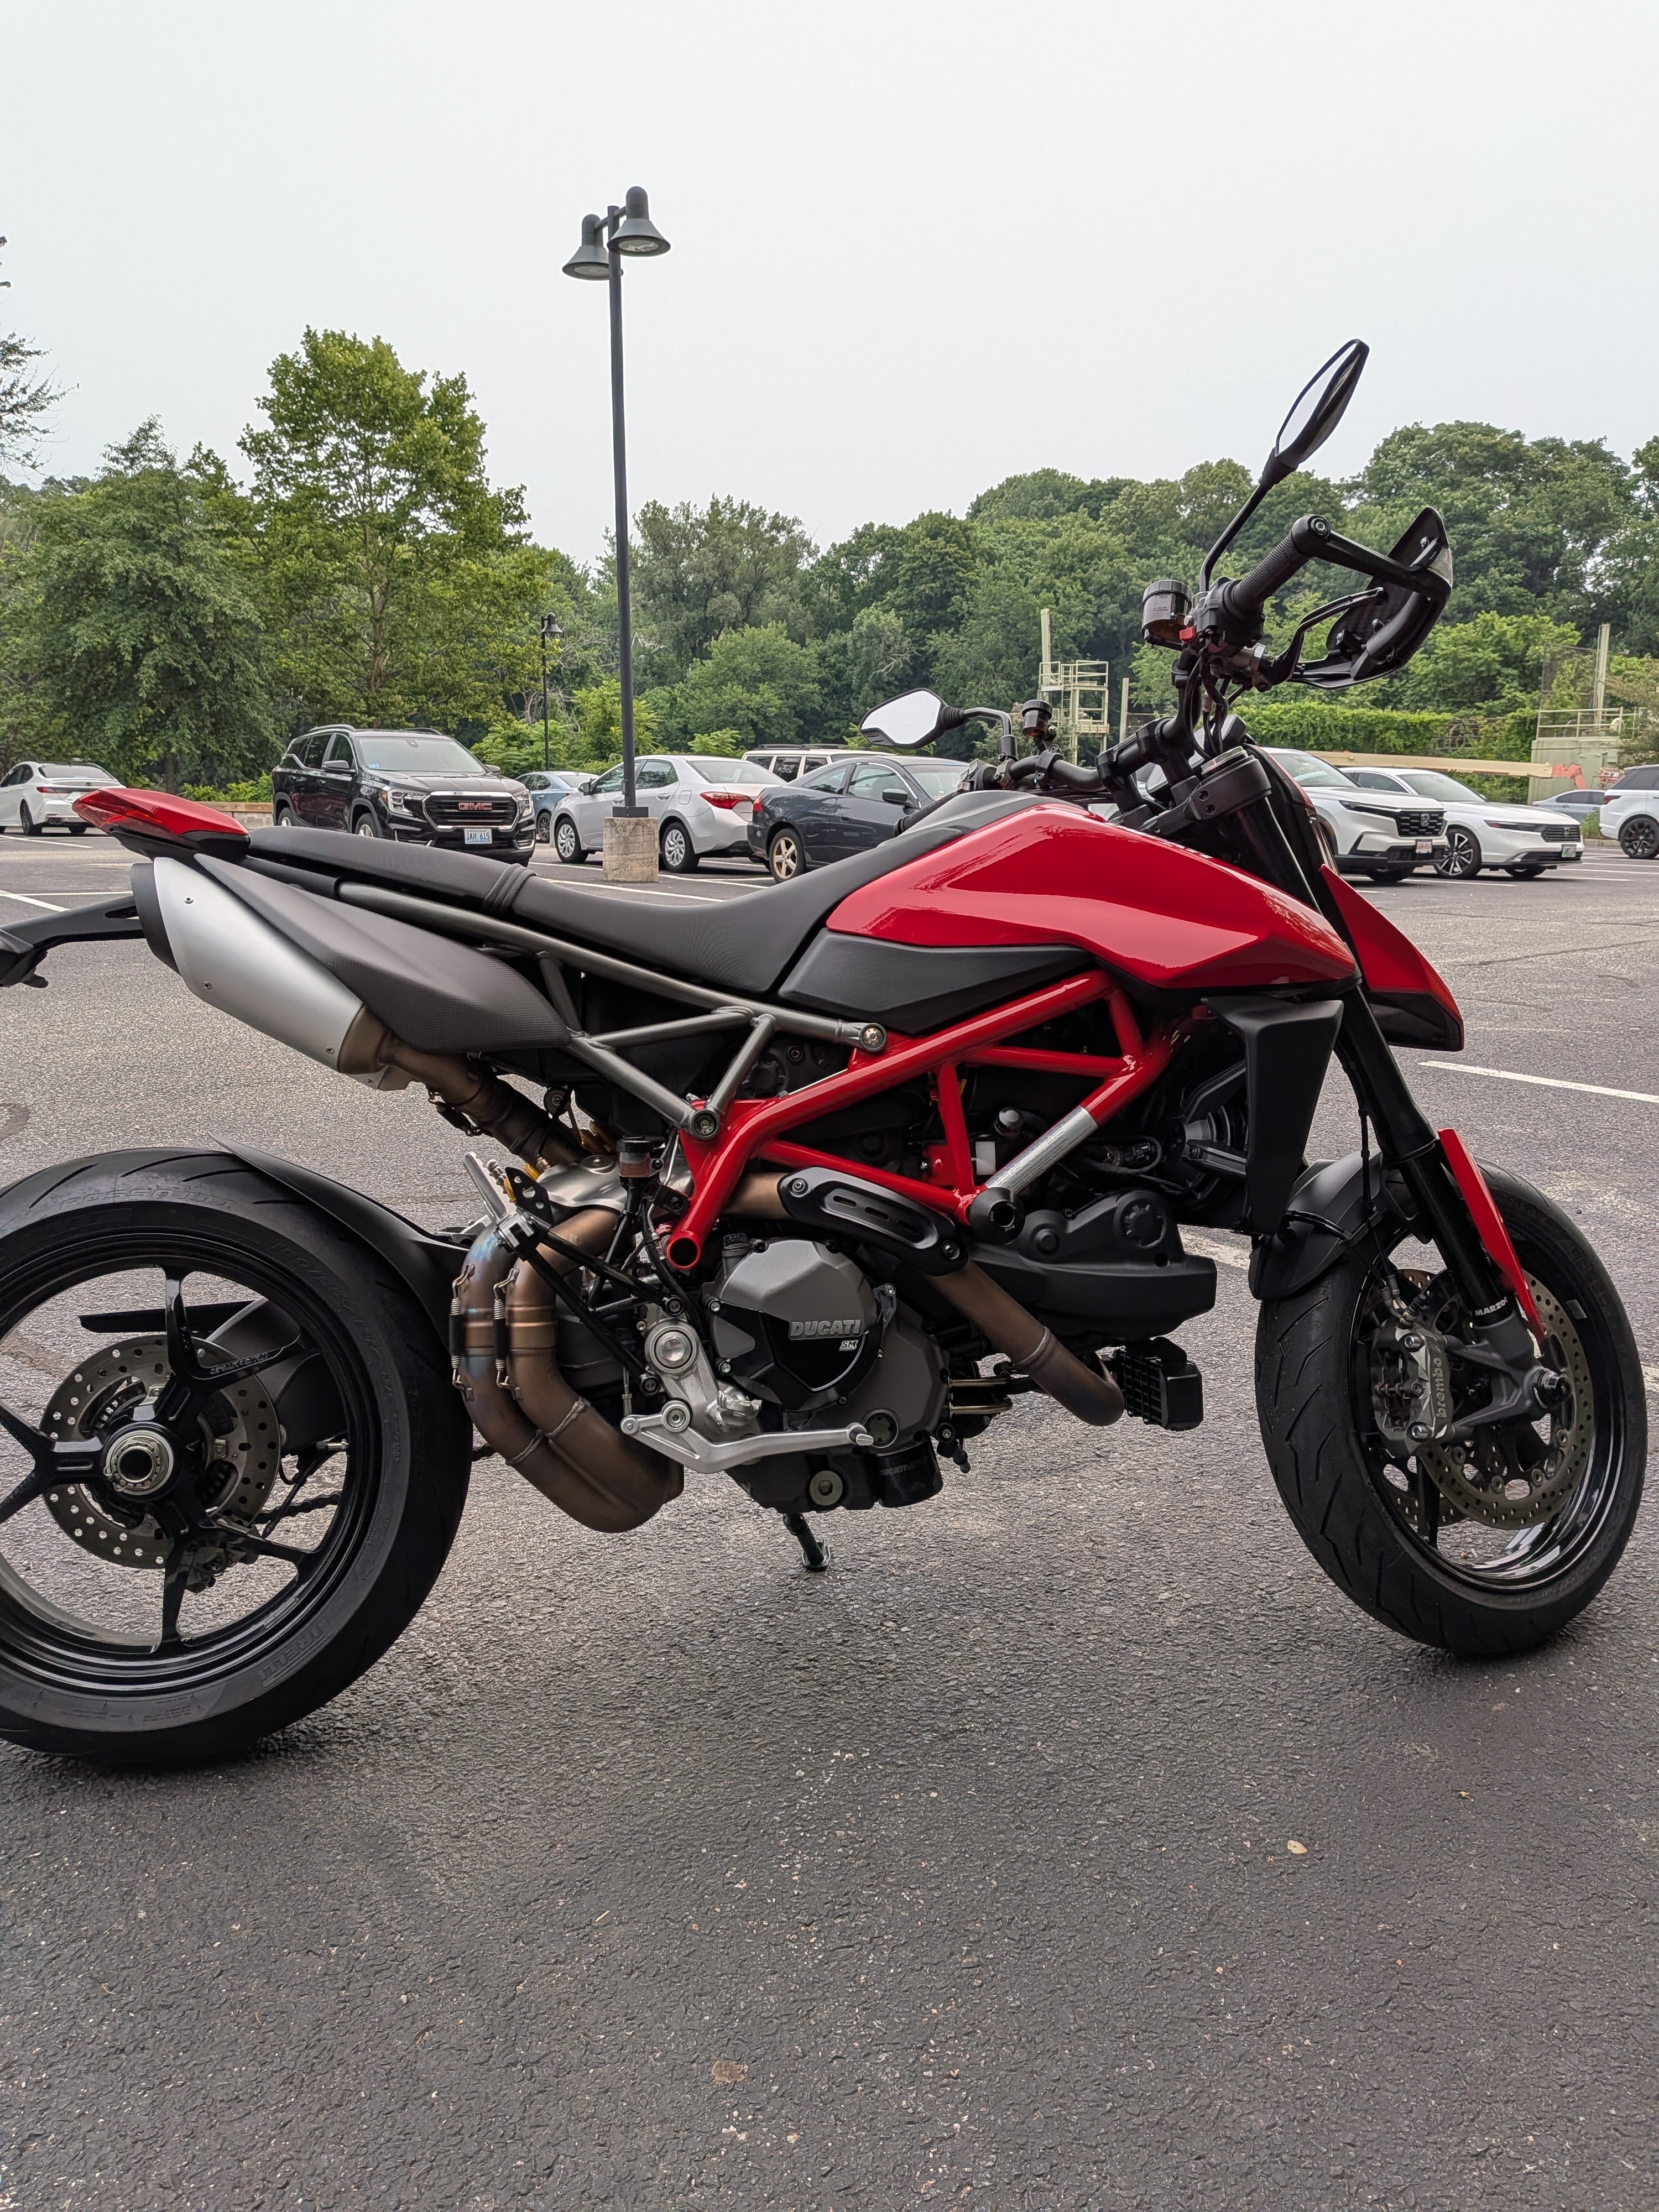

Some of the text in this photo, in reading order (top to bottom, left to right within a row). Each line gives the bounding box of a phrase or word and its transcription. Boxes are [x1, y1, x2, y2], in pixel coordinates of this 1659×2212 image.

[458, 802, 492, 811] GMC
[790, 1319, 861, 1336] DUCATI
[1432, 1358, 1447, 1418] brembo
